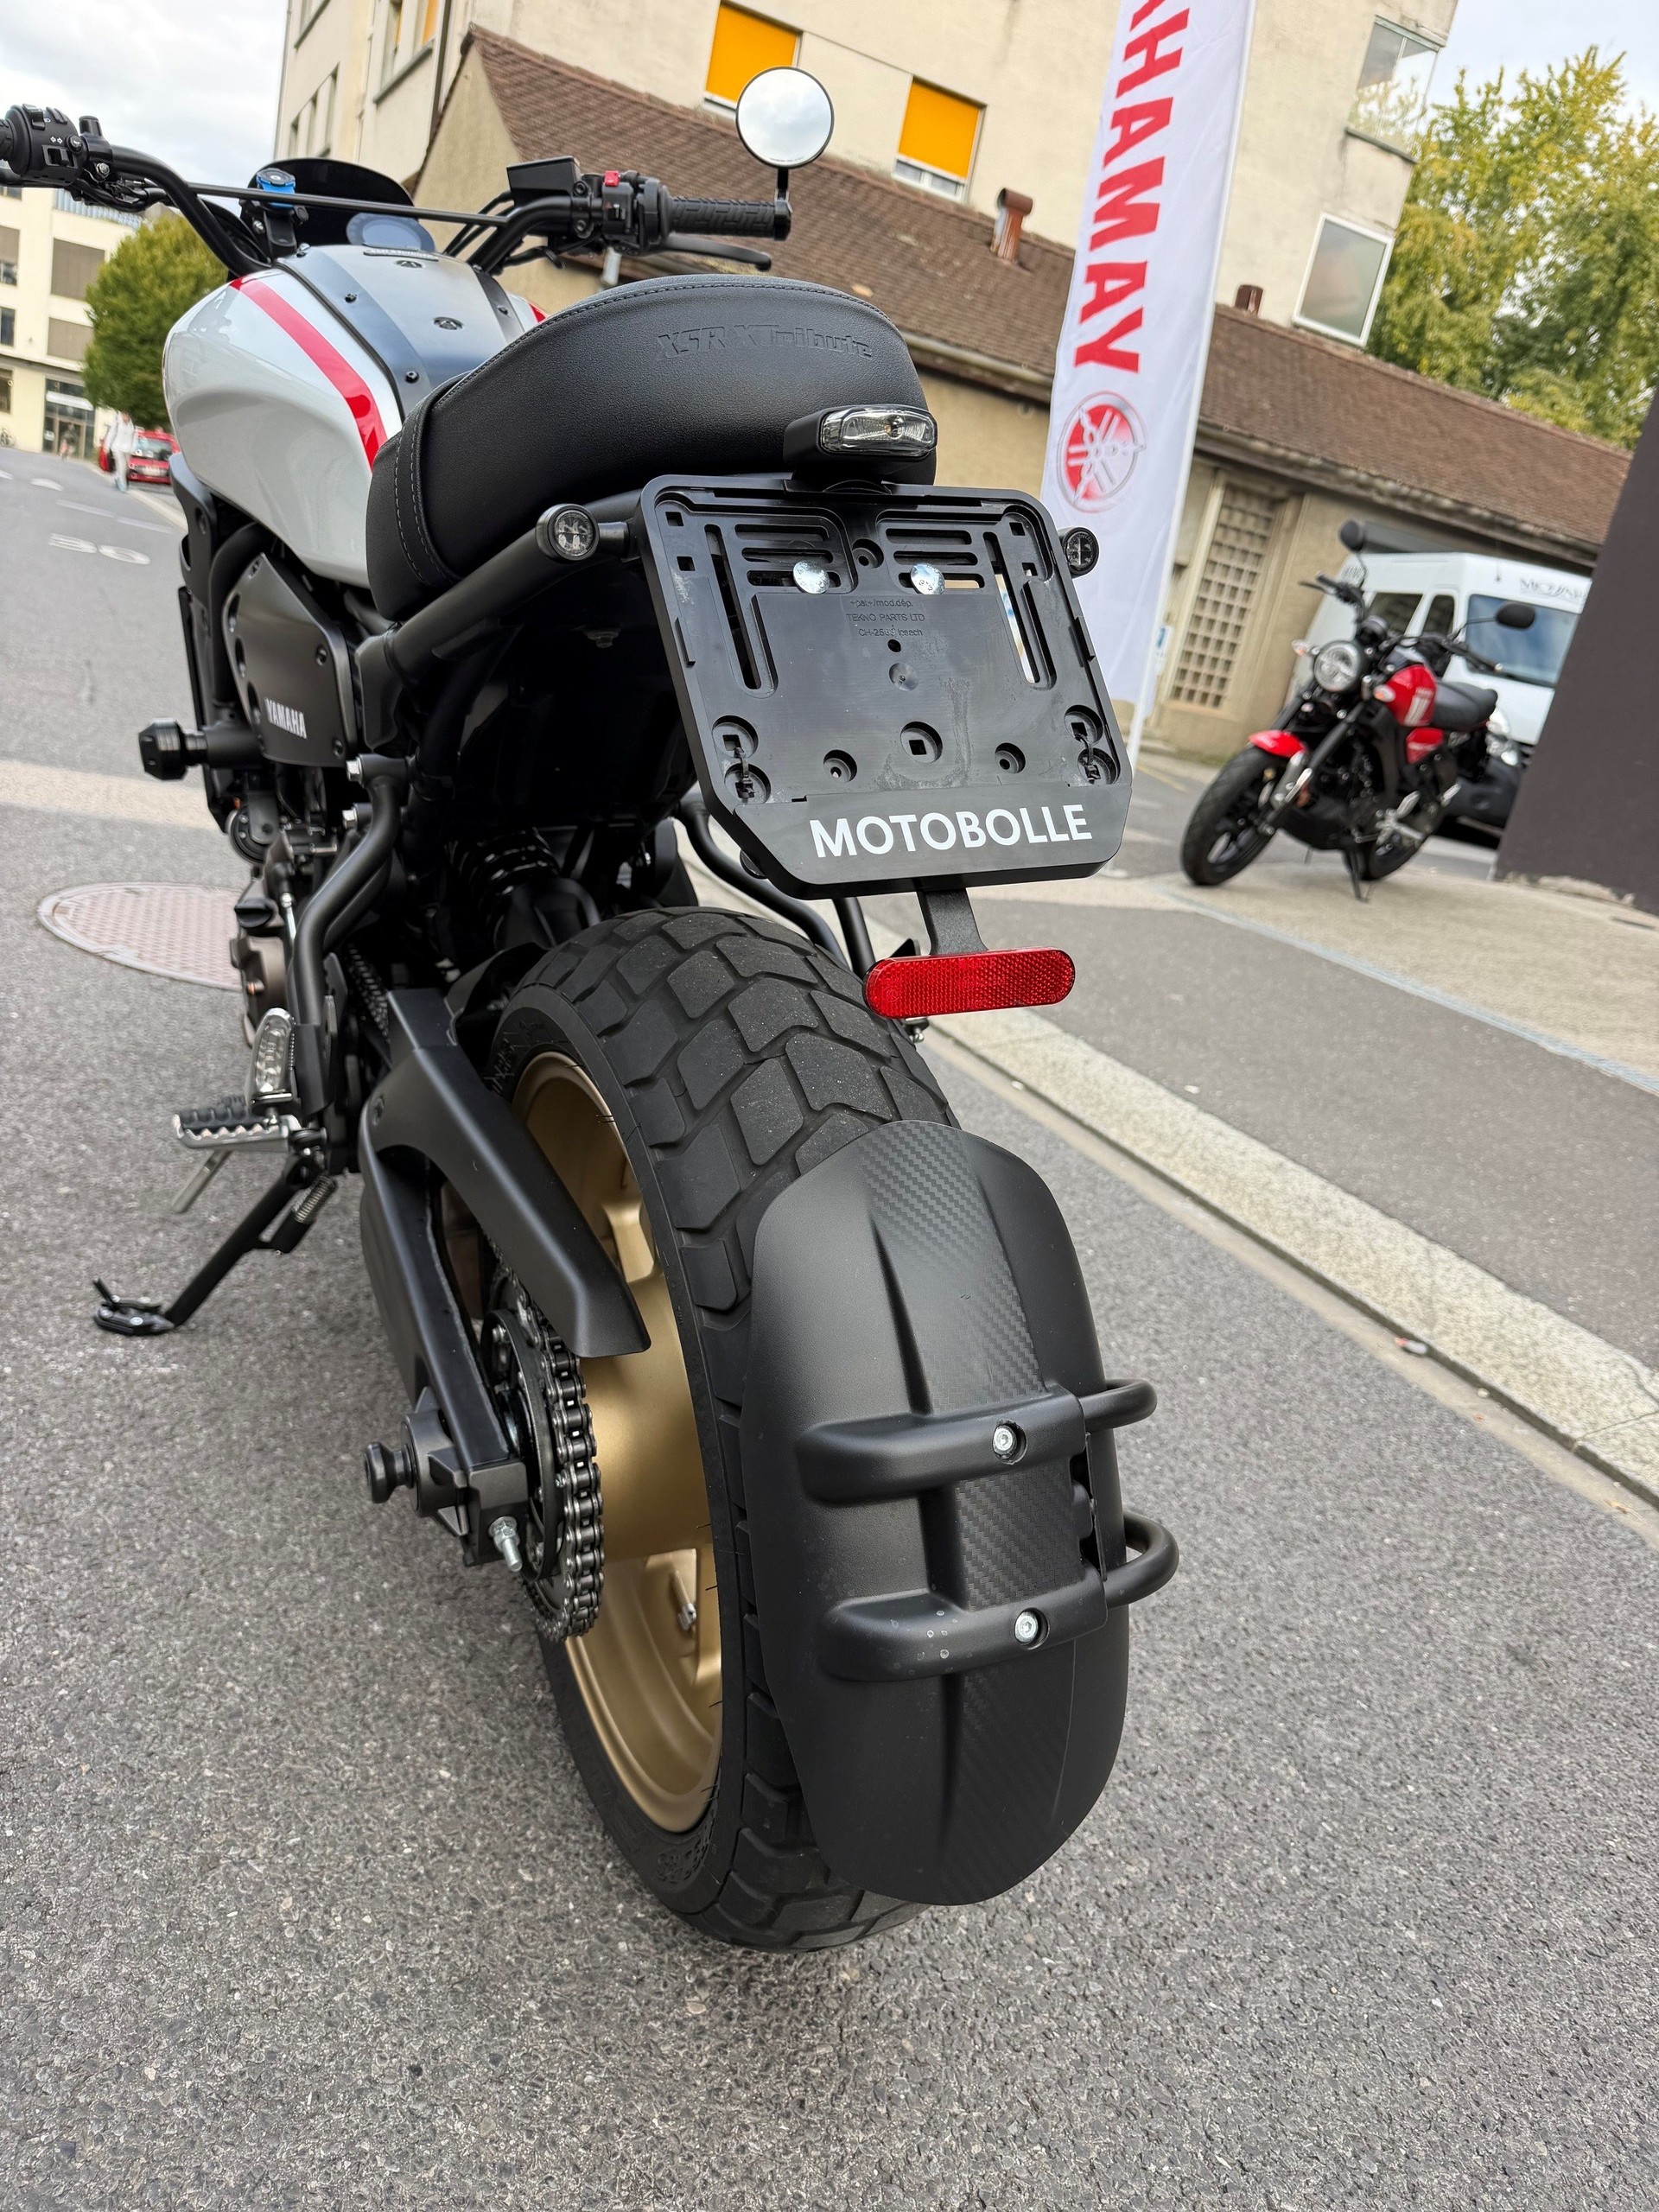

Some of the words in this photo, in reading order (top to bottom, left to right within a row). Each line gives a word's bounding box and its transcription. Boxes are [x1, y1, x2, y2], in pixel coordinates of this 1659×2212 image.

[846, 613, 877, 622] TEKNO
[879, 613, 908, 621] PARTS
[264, 696, 308, 740] YAMAHA
[809, 804, 1093, 858] MOTOBOLLE
